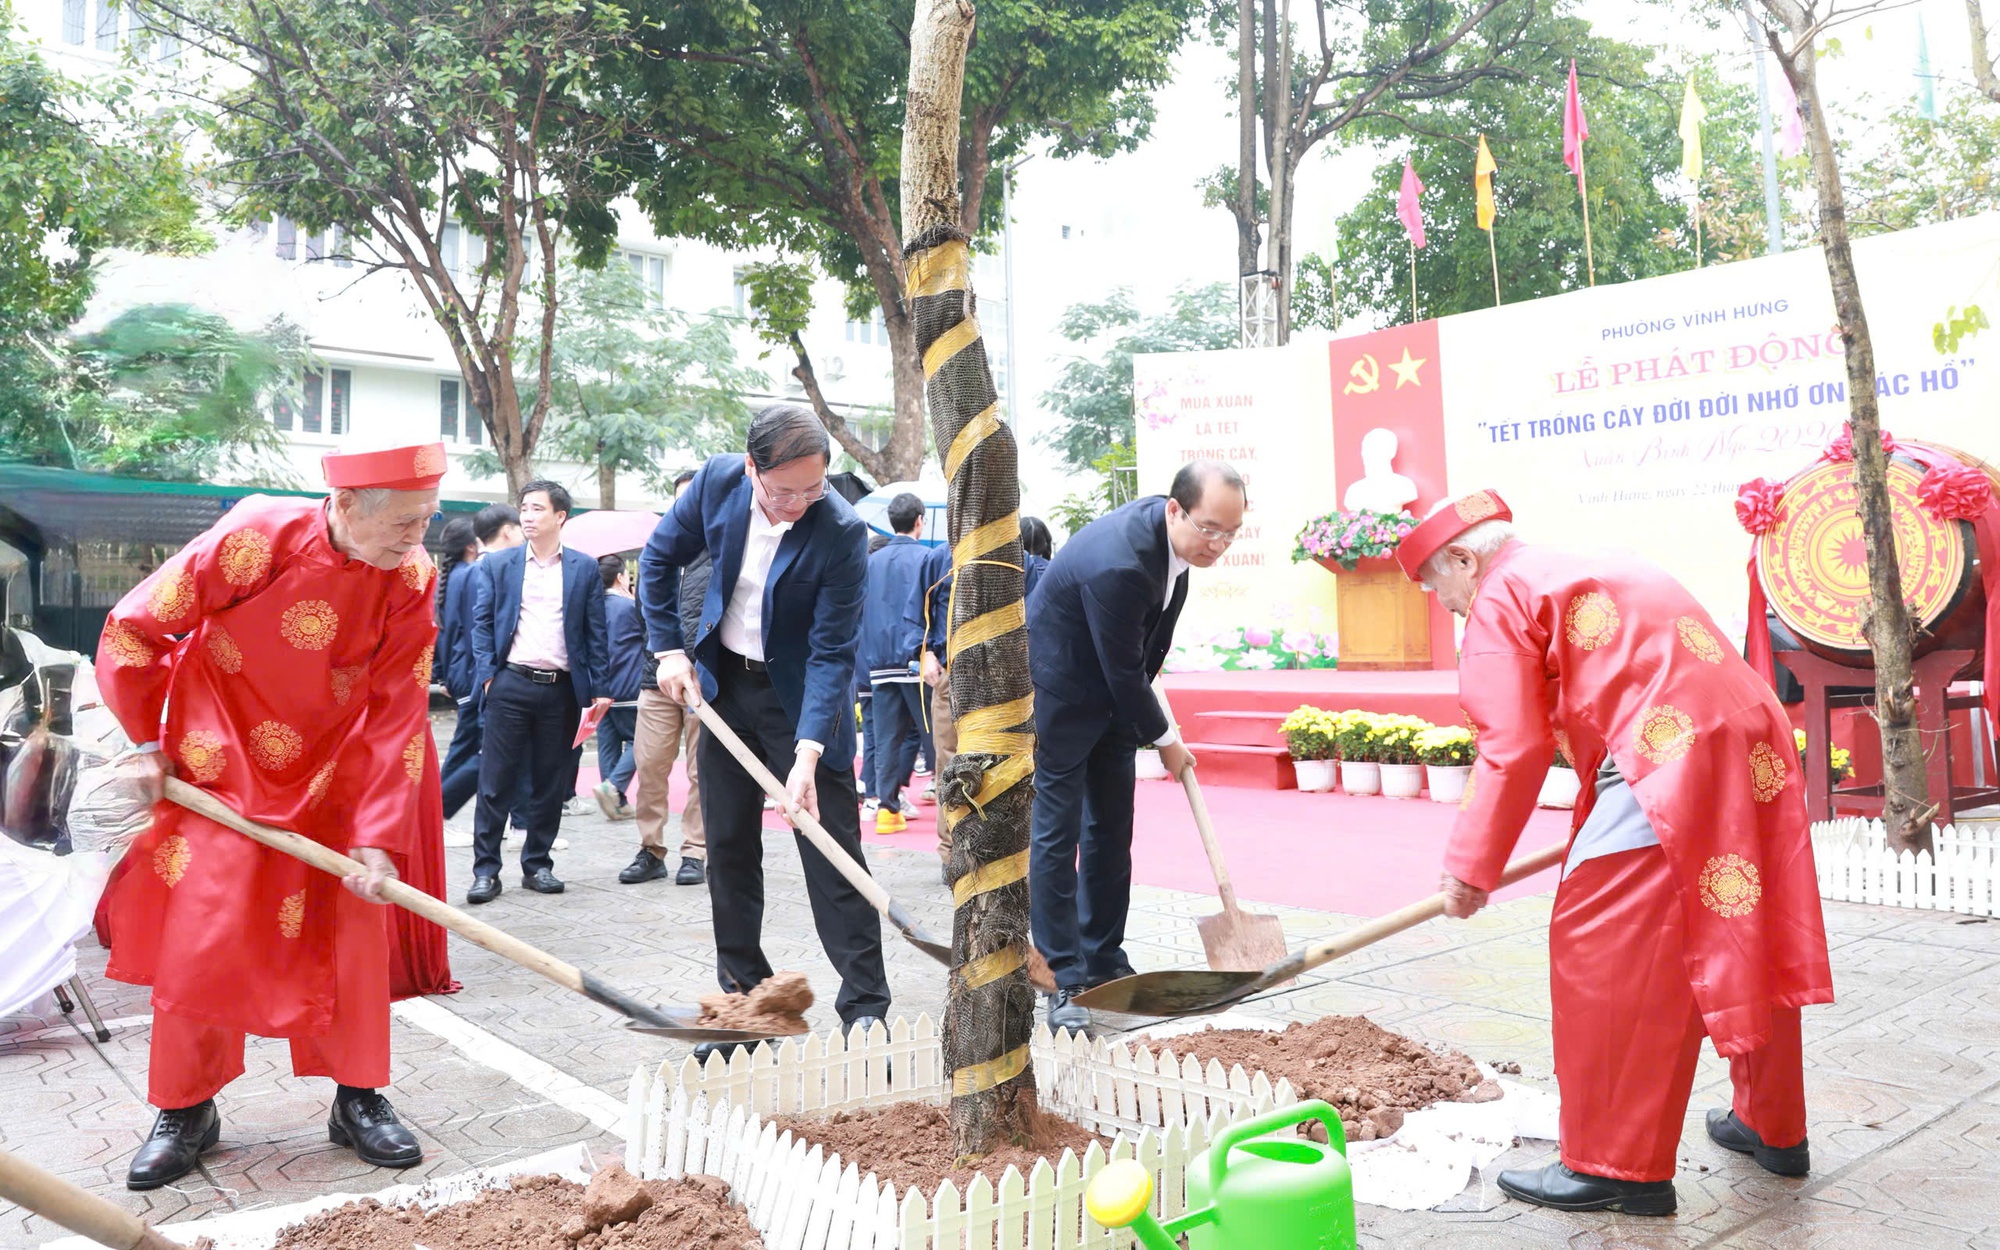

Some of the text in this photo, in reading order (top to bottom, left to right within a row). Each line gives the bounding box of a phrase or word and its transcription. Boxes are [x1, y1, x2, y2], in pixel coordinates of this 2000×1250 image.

[1733, 299, 1789, 319] HƯNG
[1610, 347, 1715, 386] PHÁT
[1603, 404, 1645, 430] CÂY
[1653, 396, 1690, 424] ĐỜI
[1699, 391, 1739, 419] ĐỜI
[1747, 383, 1799, 413] NHỚ
[1808, 381, 1845, 406] ƠN
[1874, 371, 1910, 398] ÁC
